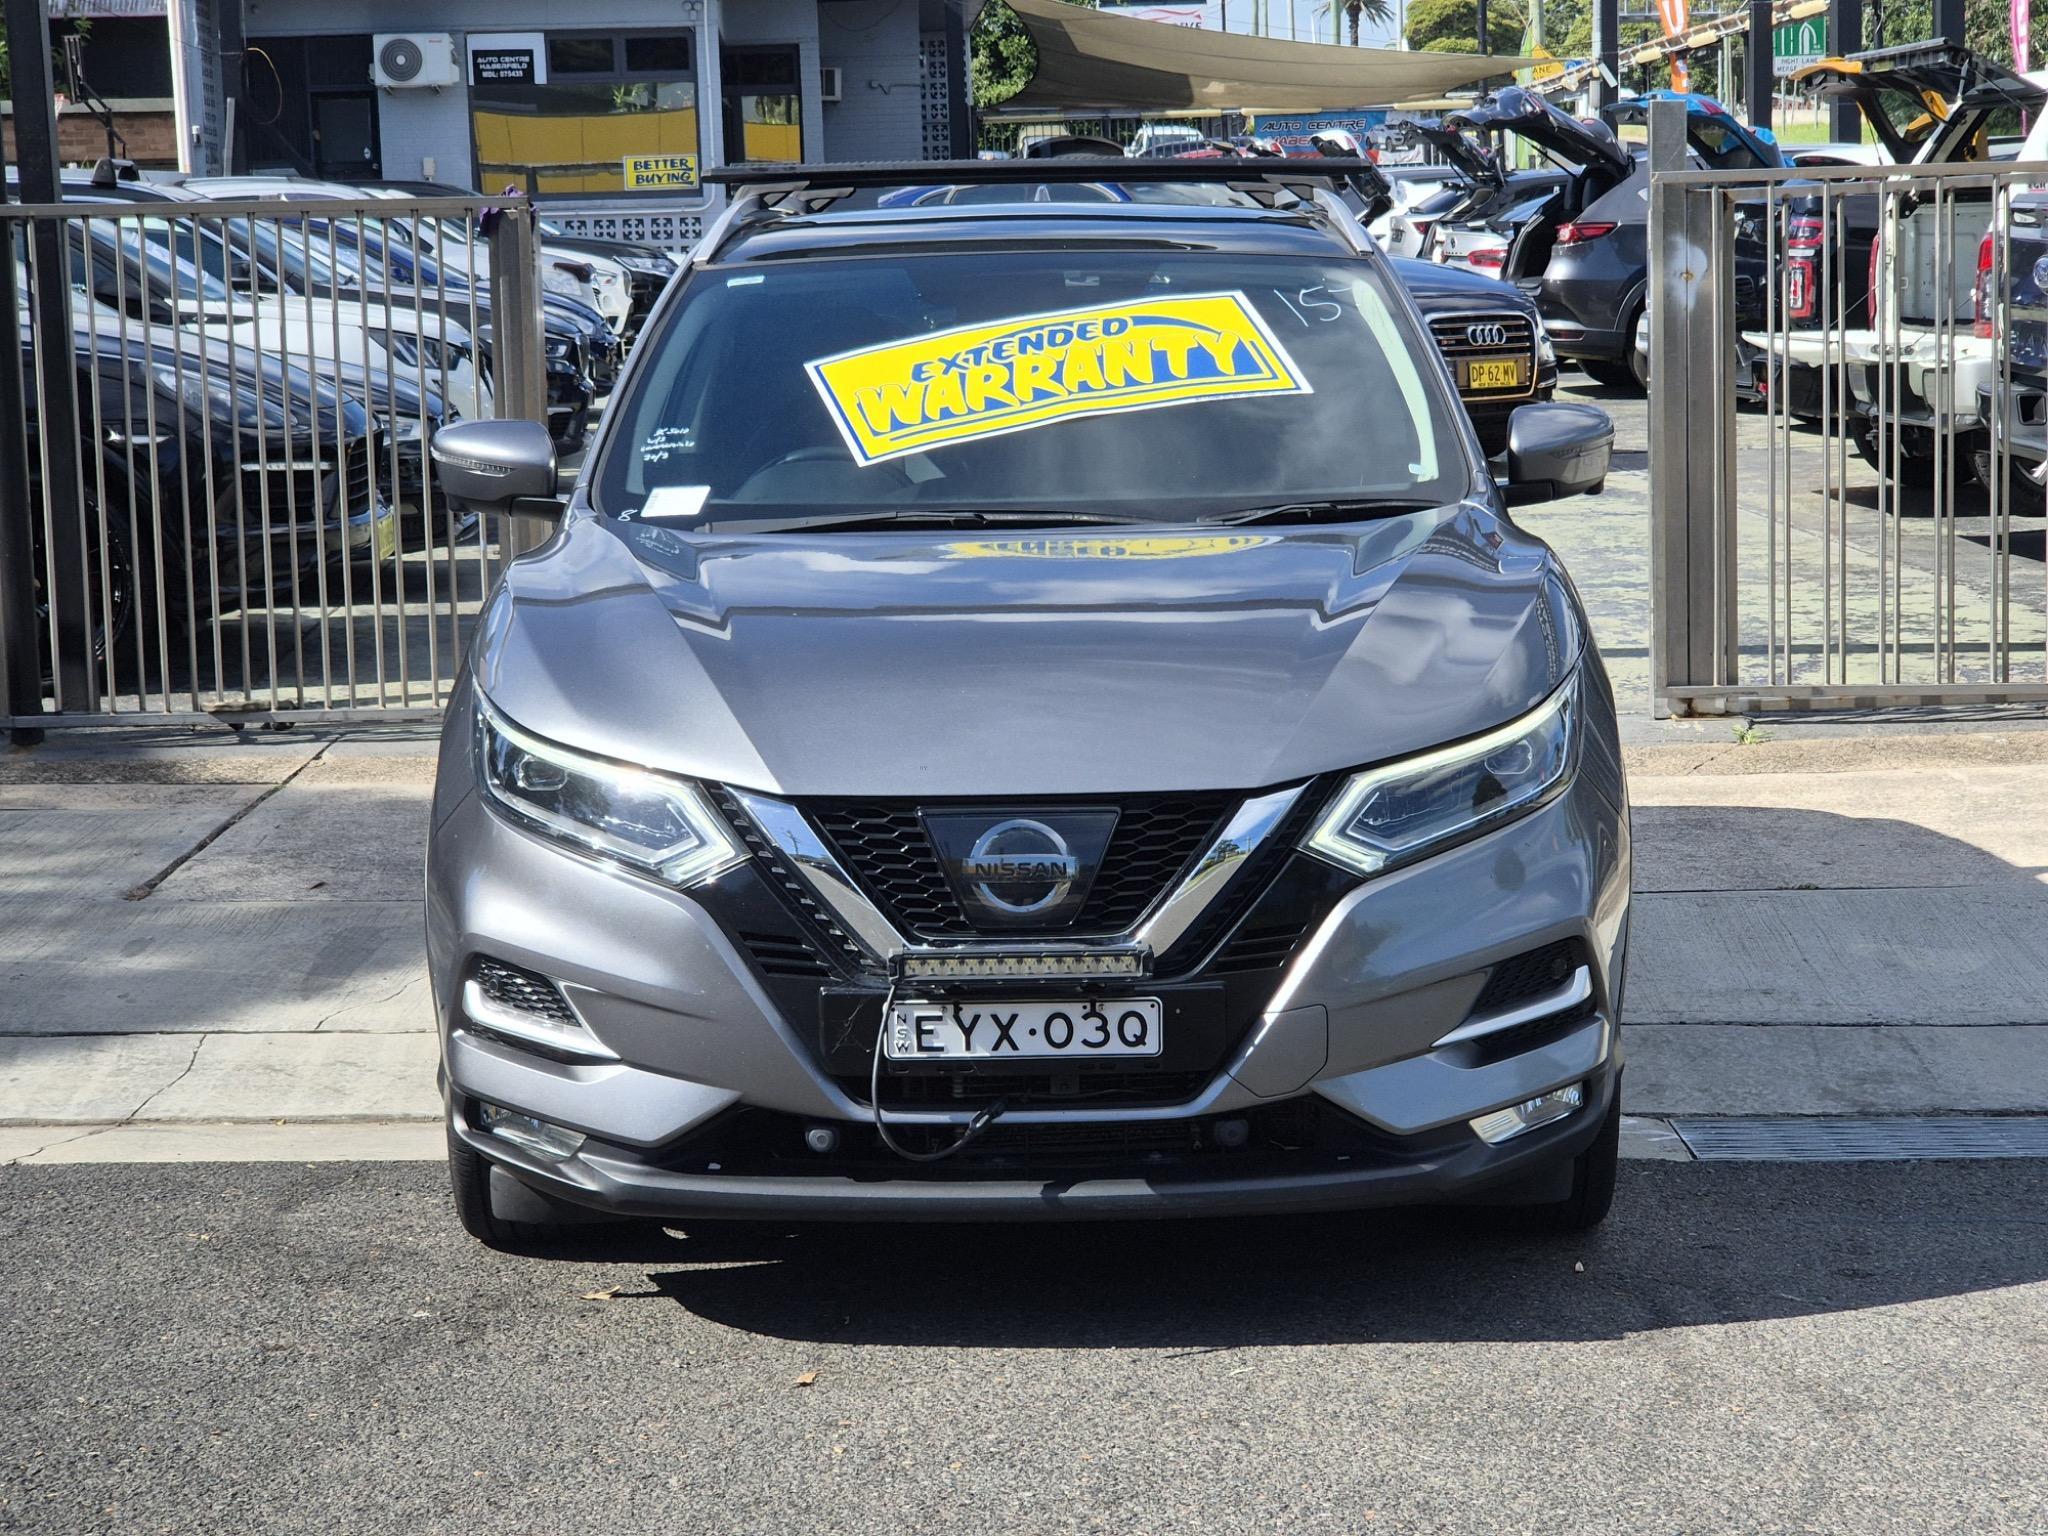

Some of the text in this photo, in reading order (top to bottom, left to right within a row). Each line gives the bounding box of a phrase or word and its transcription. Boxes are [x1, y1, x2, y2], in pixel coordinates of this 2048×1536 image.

[500, 55, 530, 63] CENTRE
[1261, 118, 1367, 132] AUTO CENTRE
[633, 158, 689, 171] BETTER
[635, 171, 691, 185] BUYING
[910, 316, 1131, 383] EXTENDED
[855, 331, 1241, 435] WARRANTY
[974, 861, 1067, 877] NISSAN
